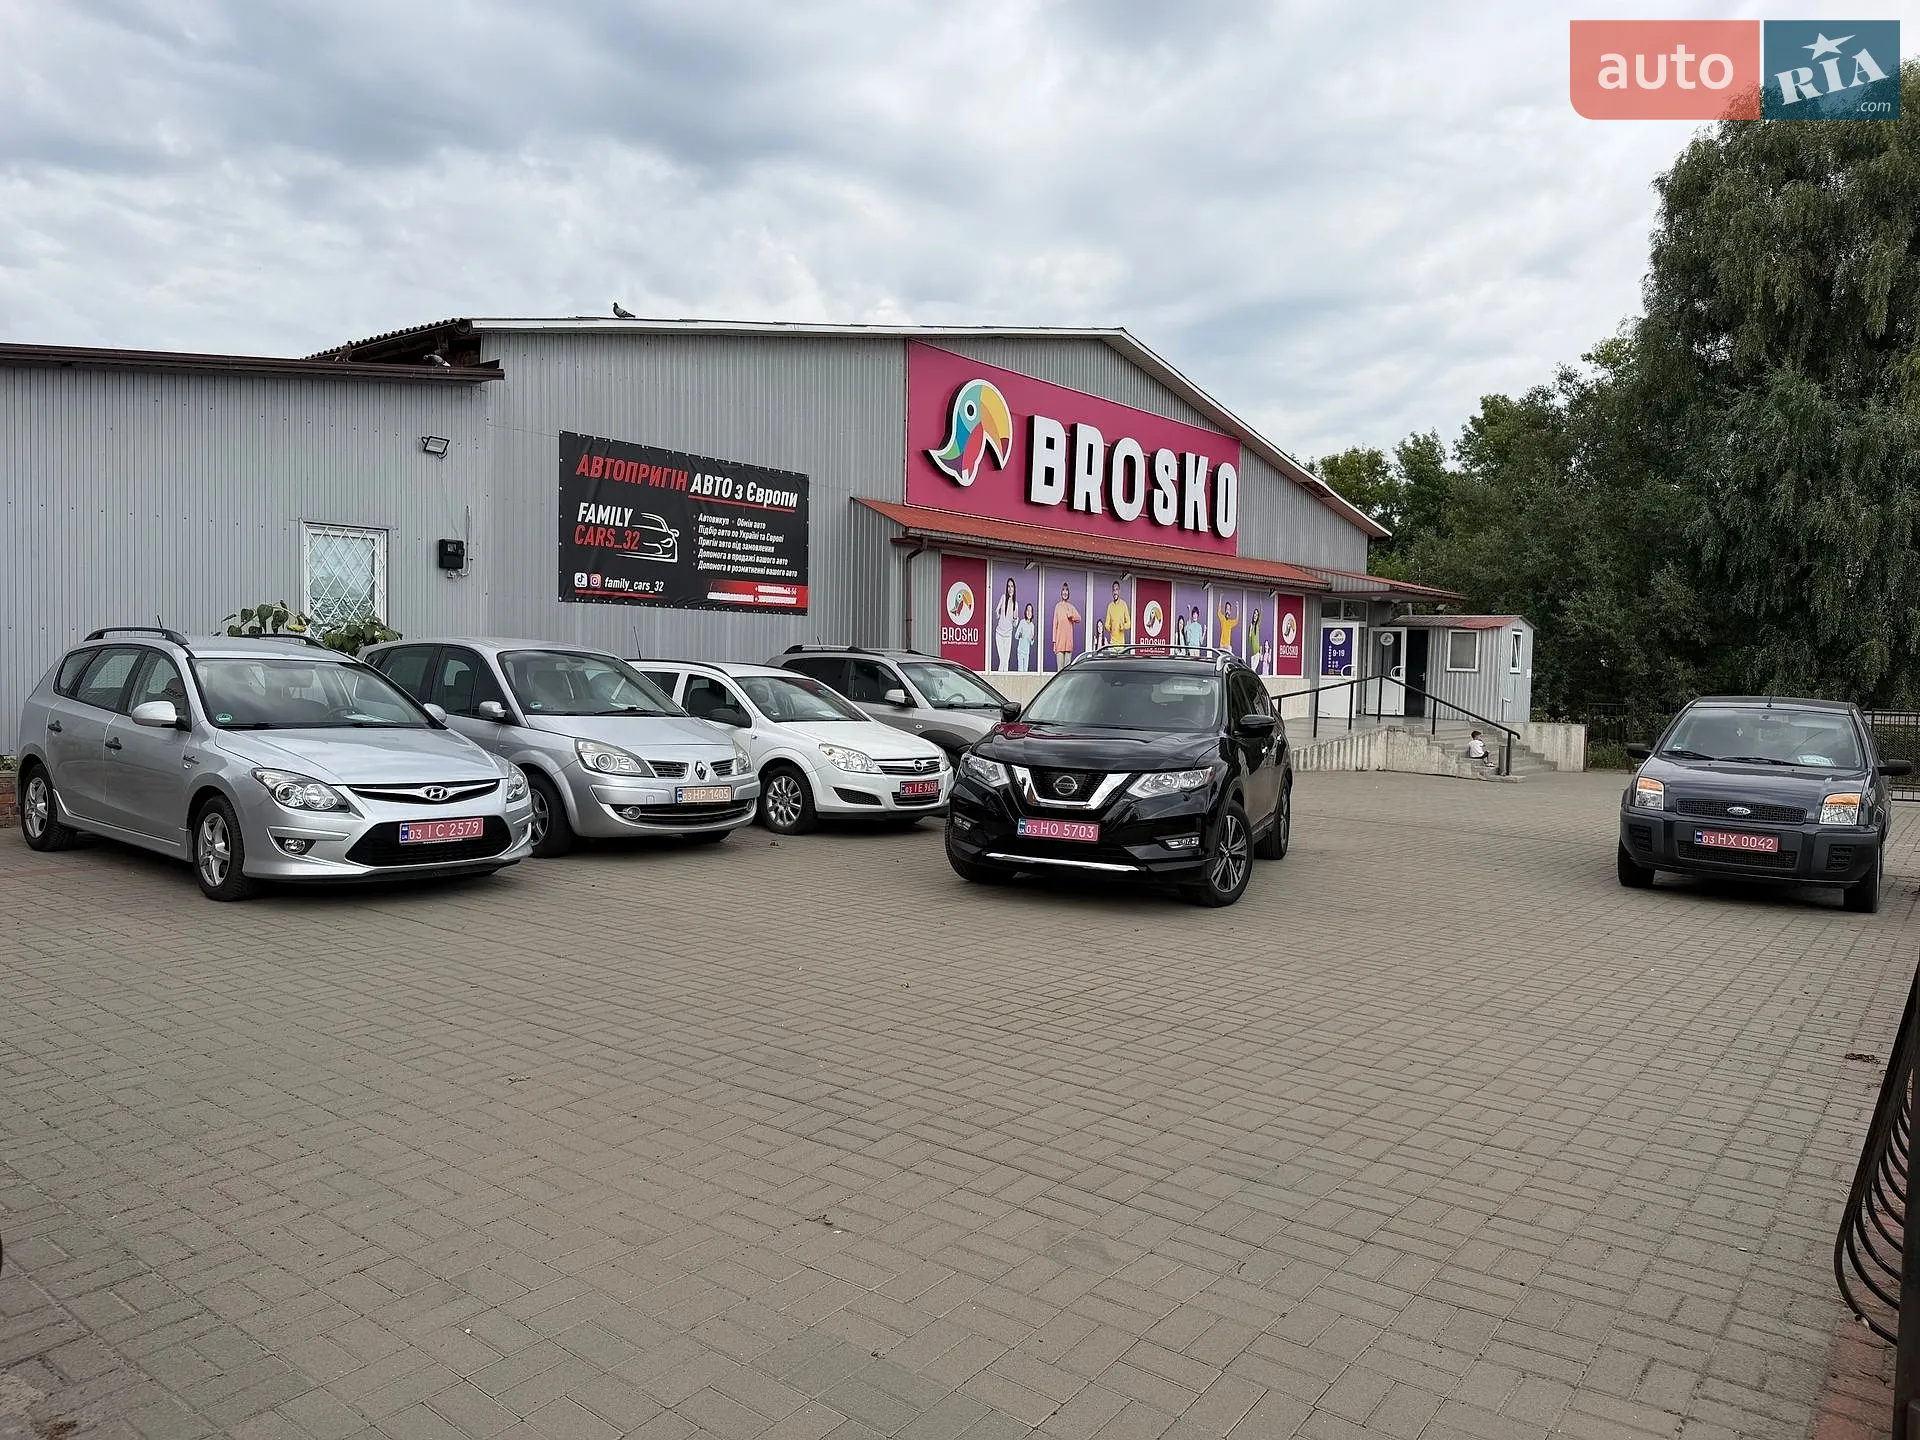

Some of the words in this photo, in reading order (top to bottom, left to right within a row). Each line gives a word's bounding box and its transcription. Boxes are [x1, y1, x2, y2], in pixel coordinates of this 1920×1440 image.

[576, 453, 688, 491] АВТОПРИГІН
[690, 473, 733, 498] АВТО
[734, 484, 744, 500] з
[746, 481, 798, 507] Європи
[1029, 414, 1238, 539] BROSKO
[577, 502, 634, 527] FAMILY
[698, 525, 718, 537] Підбір
[718, 529, 731, 537] авто
[739, 530, 760, 541] Україні
[753, 521, 766, 529] авто
[574, 525, 641, 550] CARS_32
[698, 537, 719, 548] Пригін
[719, 541, 732, 549] авто
[697, 548, 727, 560] Допомога
[756, 556, 776, 565] вашого
[776, 558, 789, 566] авто
[697, 560, 727, 571] Допомога
[786, 570, 798, 578] авто
[604, 577, 665, 594] family_cars_32
[941, 627, 979, 642] BROSKO
[693, 789, 707, 800] HP
[409, 829, 422, 840] 03
[449, 821, 479, 836] 2579
[1026, 825, 1038, 834] 03
[1040, 822, 1059, 836] HO
[1063, 824, 1095, 839] 5703
[1703, 835, 1715, 844] 03
[1718, 833, 1737, 846] HX
[1741, 836, 1774, 850] 0042
